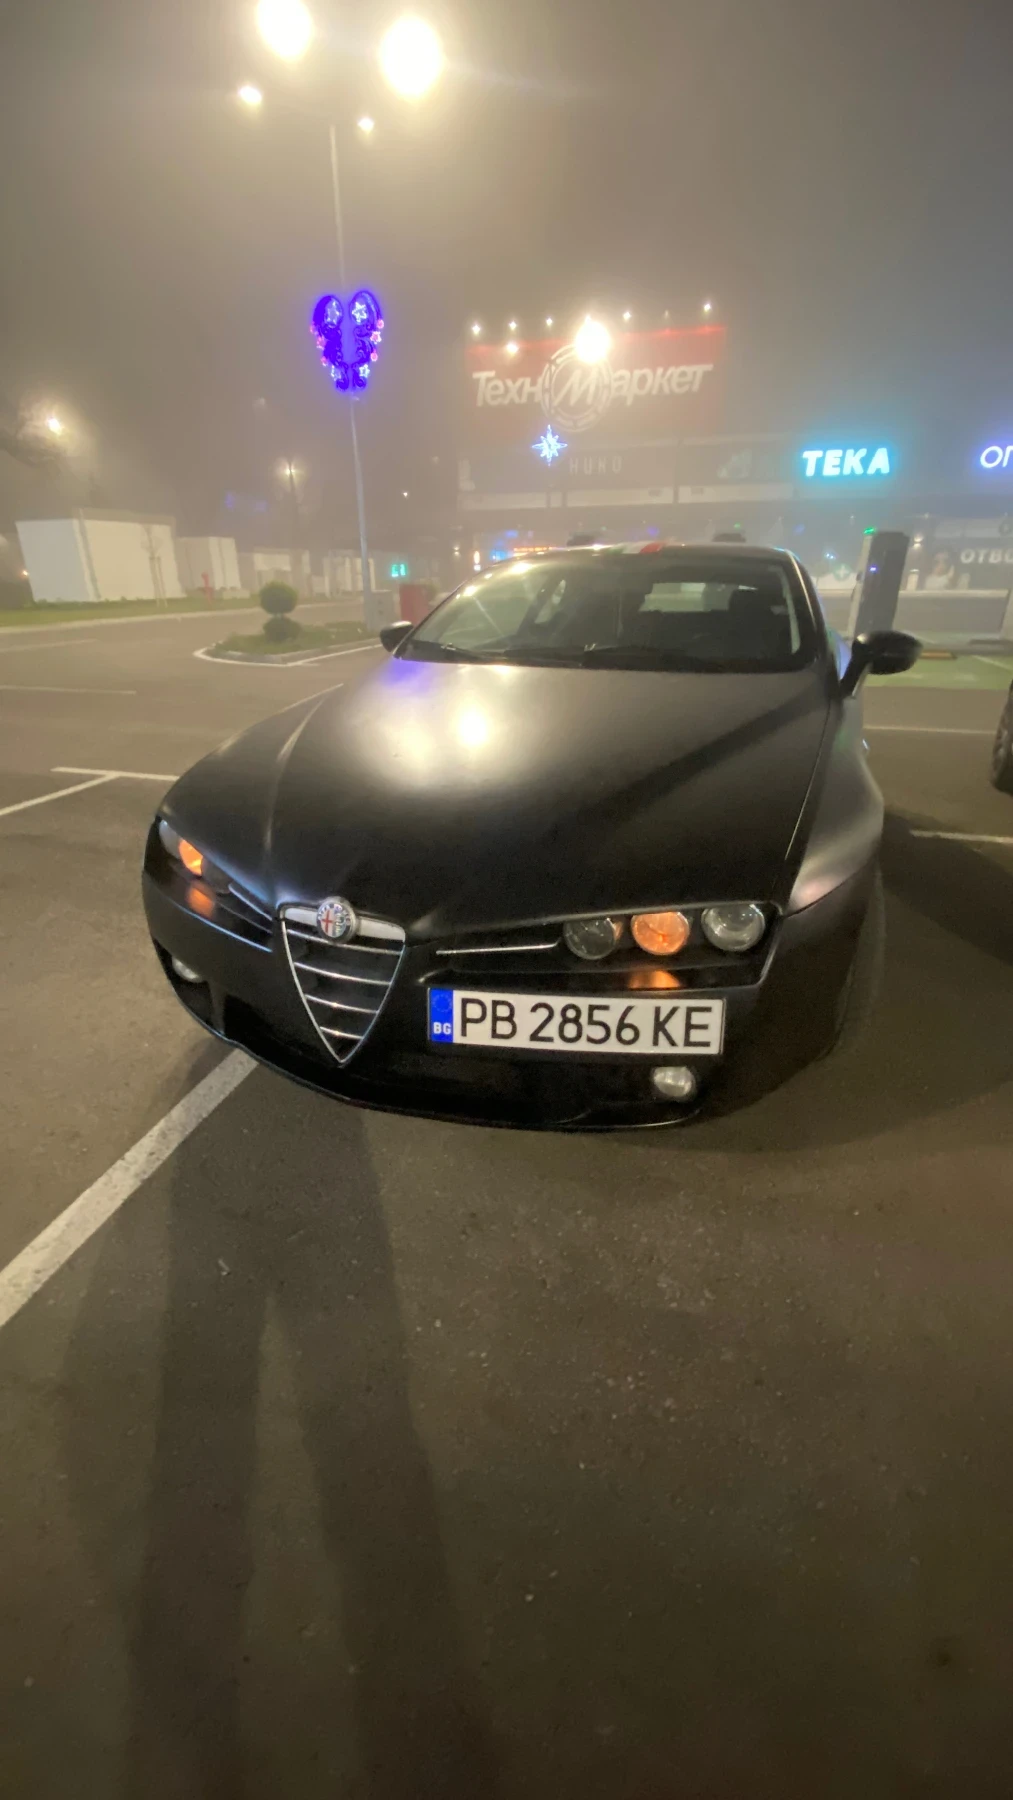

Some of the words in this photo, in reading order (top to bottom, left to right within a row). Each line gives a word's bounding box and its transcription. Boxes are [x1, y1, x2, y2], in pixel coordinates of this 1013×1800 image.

[433, 1021, 452, 1035] BG
[460, 997, 518, 1040] PB
[529, 1002, 641, 1046] 2856
[652, 1005, 713, 1048] KE
